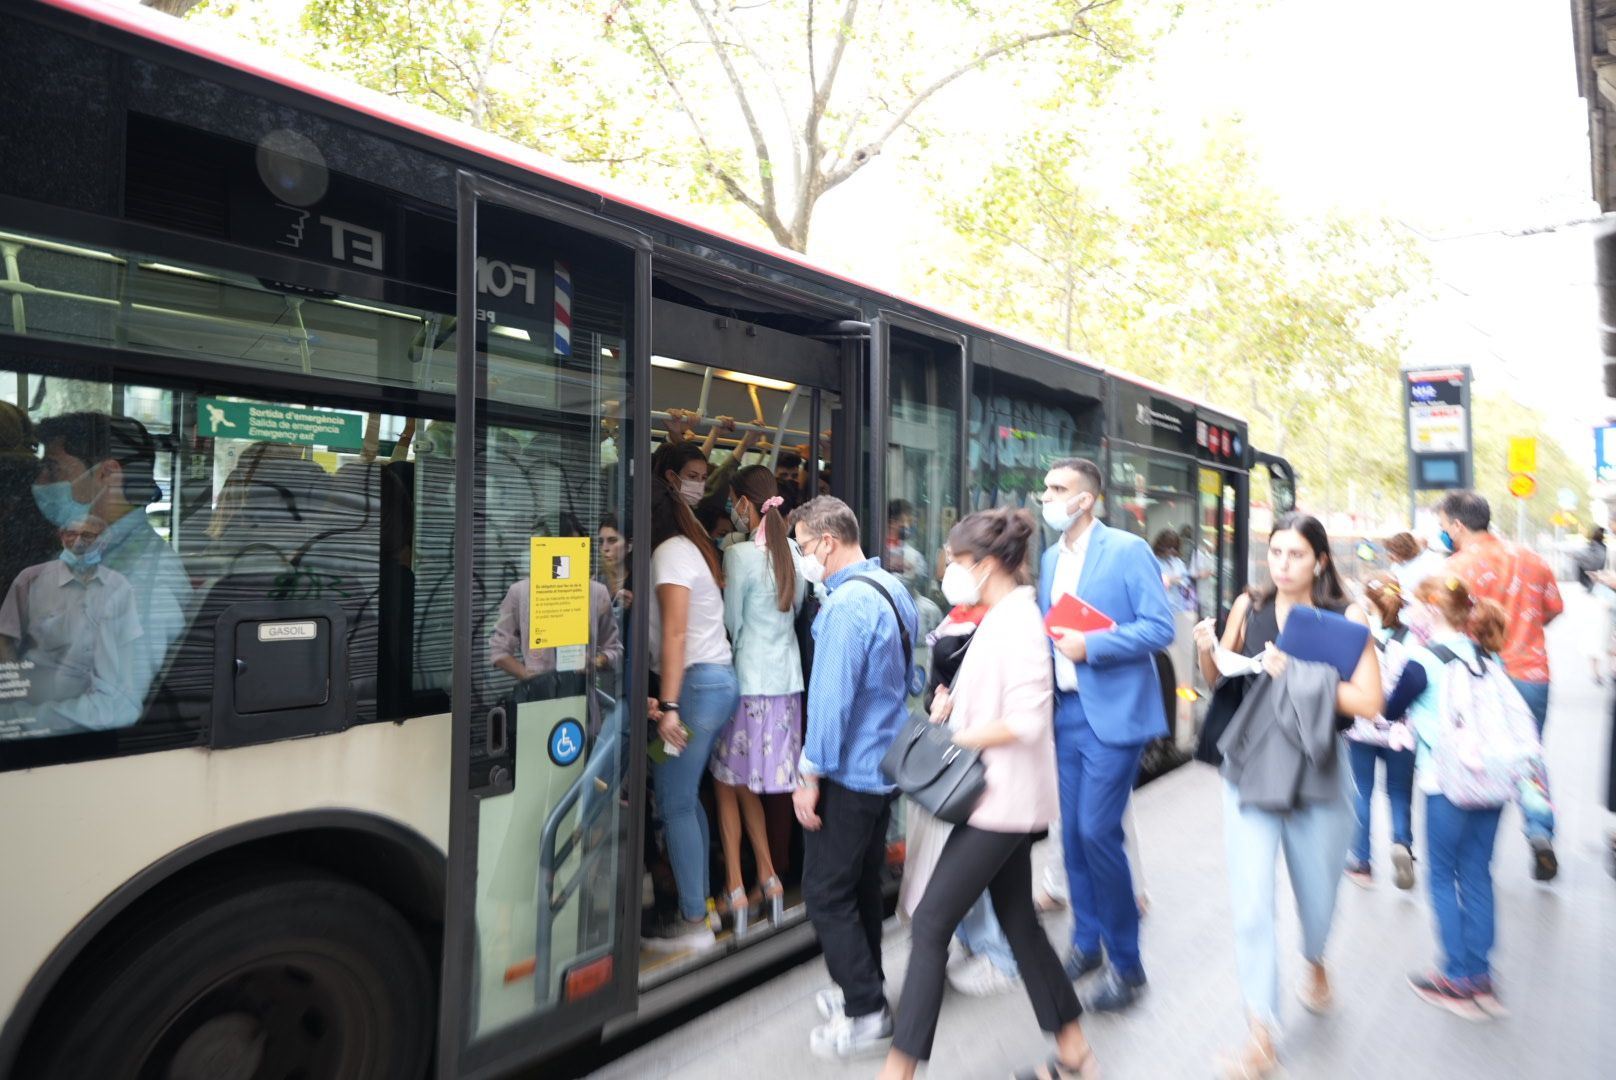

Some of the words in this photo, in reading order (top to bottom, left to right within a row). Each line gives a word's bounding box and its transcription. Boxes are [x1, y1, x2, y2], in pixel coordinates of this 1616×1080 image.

[249, 407, 284, 419] Sortida
[285, 410, 345, 425] d'emergència
[249, 417, 278, 428] Salida
[278, 421, 291, 429] de
[292, 423, 340, 434] emergencia
[249, 427, 298, 440] Emergency
[299, 432, 315, 441] exit
[268, 626, 306, 636] GASOIL
[21, 660, 35, 670] de
